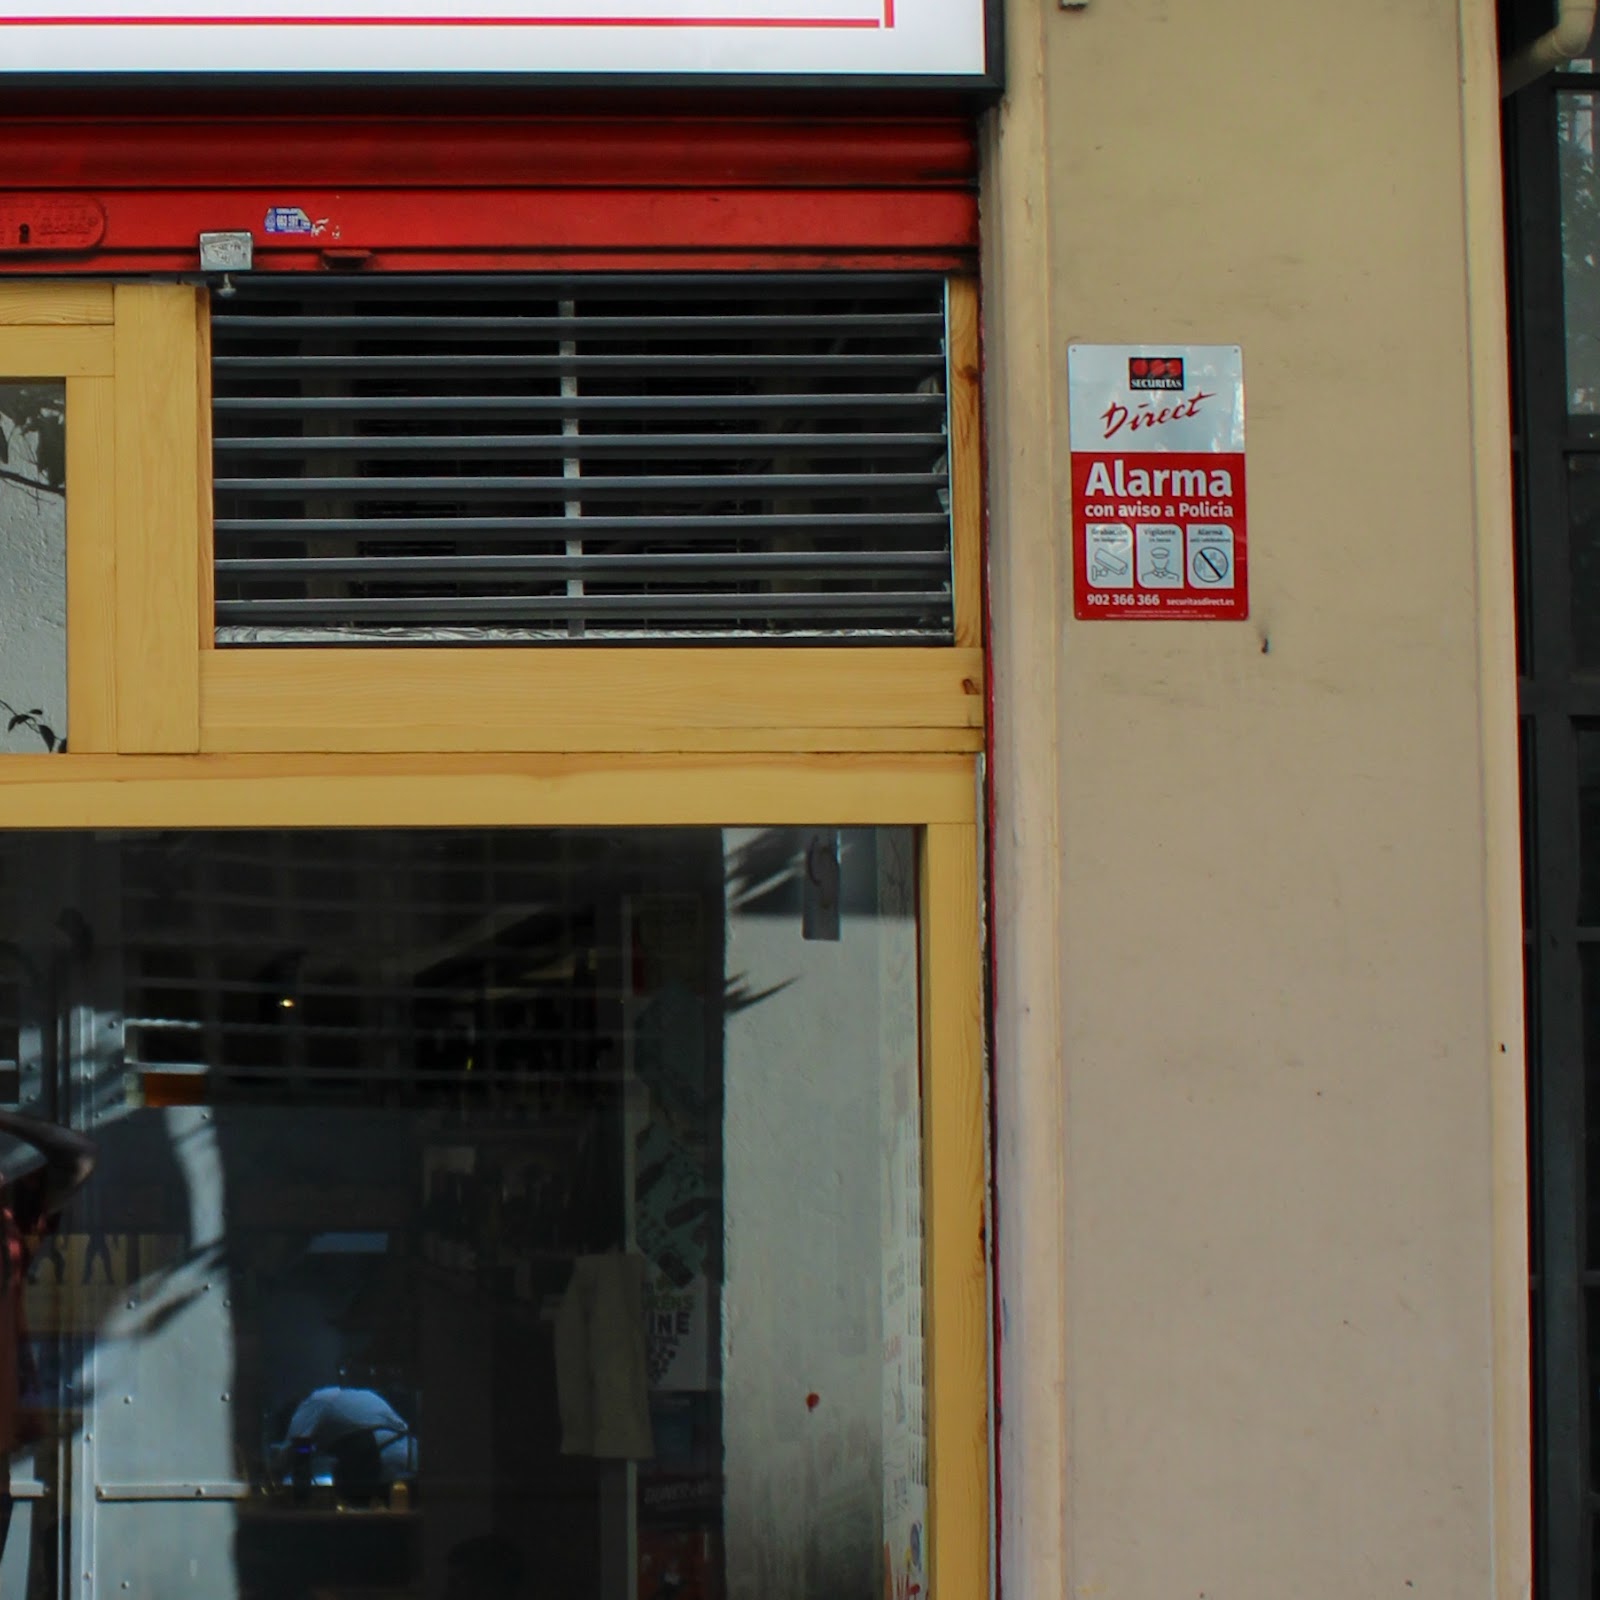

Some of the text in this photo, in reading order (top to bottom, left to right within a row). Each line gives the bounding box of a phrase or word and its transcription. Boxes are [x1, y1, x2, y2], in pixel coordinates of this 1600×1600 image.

[1131, 378, 1183, 389] SECURITAS
[1100, 391, 1216, 439] Direct
[1084, 459, 1233, 498] Alarma
[1084, 500, 1234, 517] con aviso a Policía
[1086, 594, 1160, 606] 902 366 366
